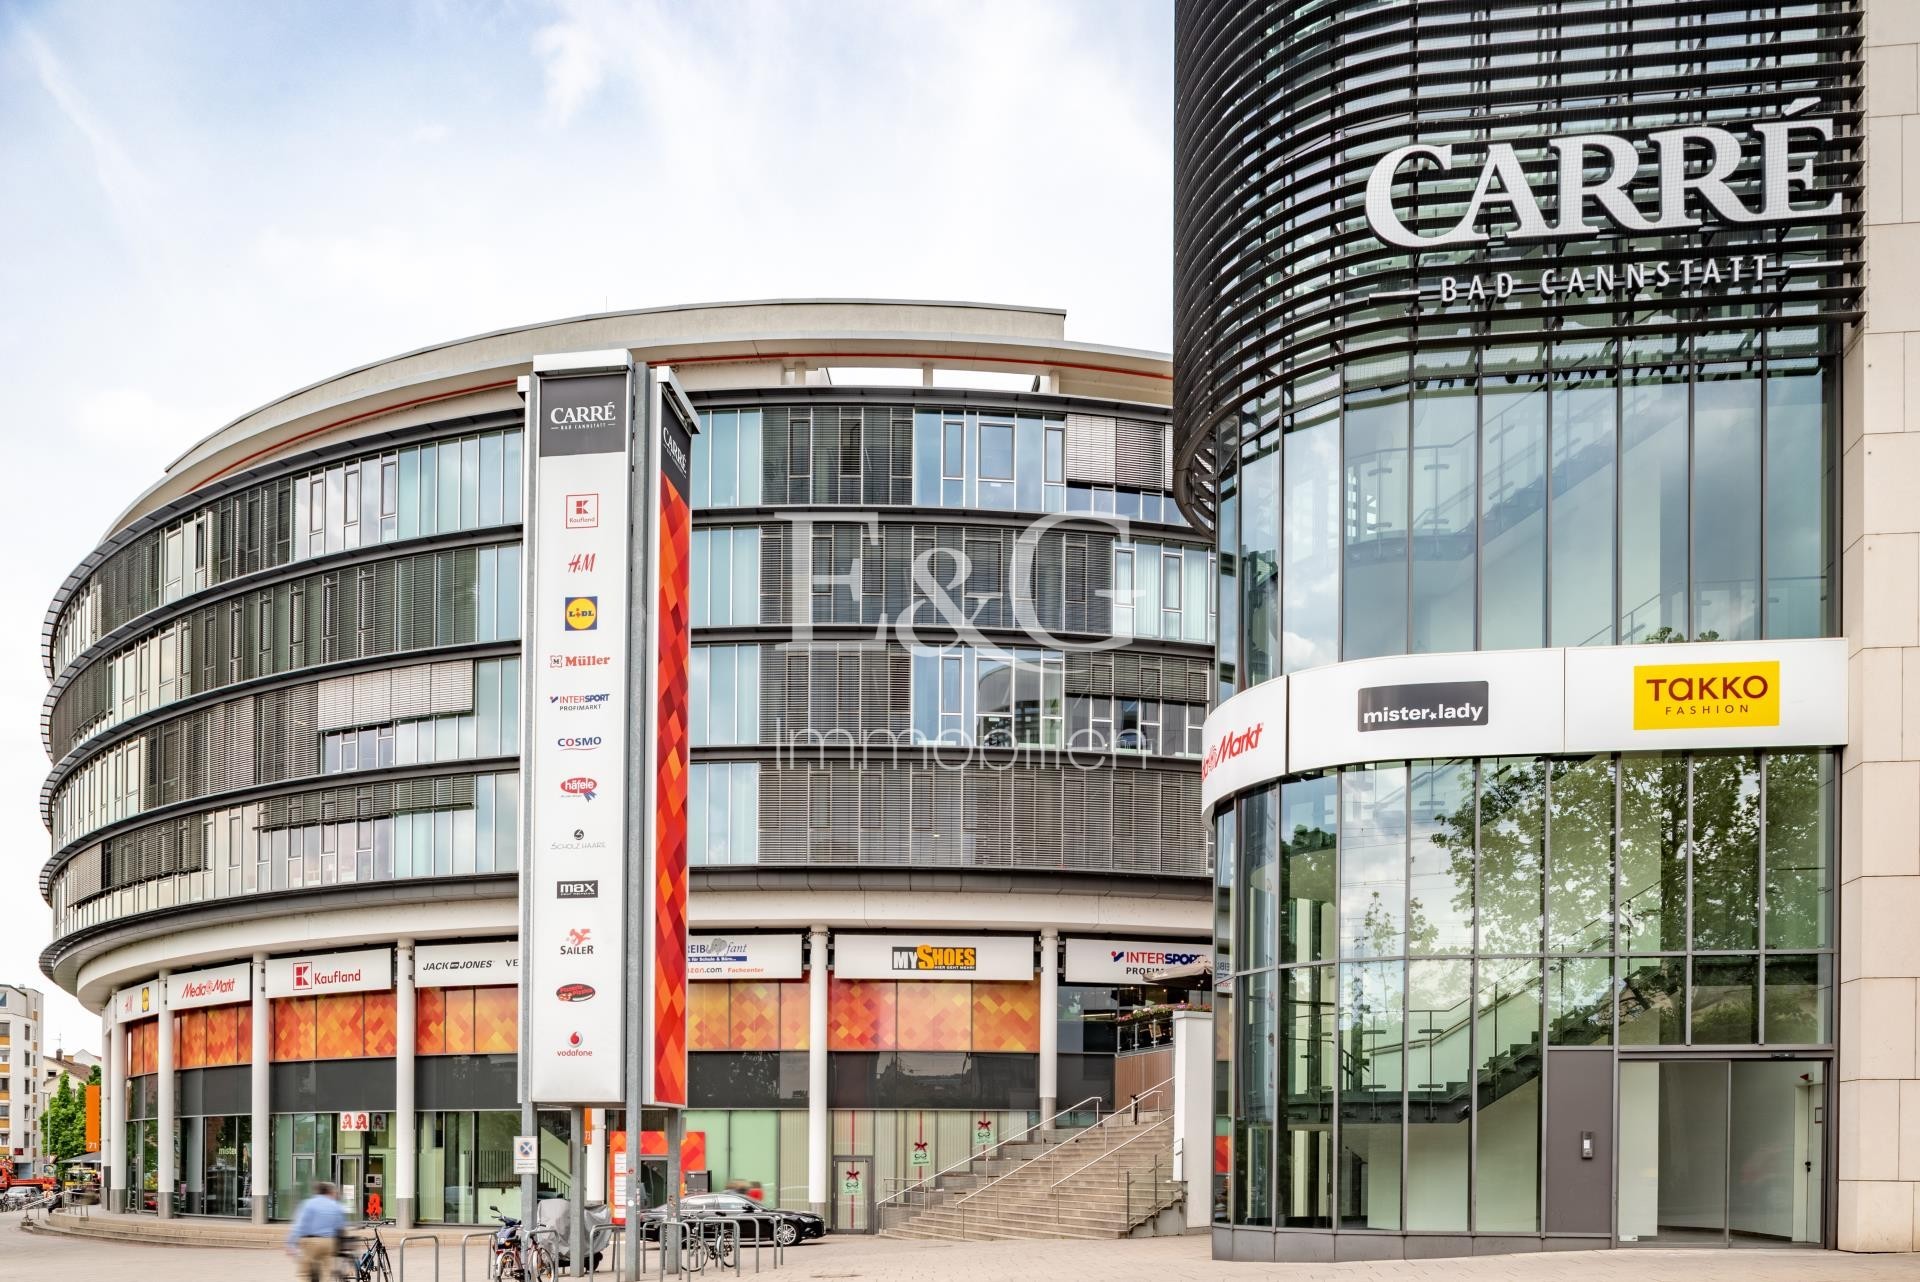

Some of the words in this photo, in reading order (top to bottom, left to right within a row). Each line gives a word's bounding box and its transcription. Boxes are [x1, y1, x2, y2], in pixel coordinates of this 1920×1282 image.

[1364, 96, 1843, 249] CARRÉ
[1440, 272, 1514, 303] BAD
[1541, 254, 1768, 297] CANNSTATT
[550, 401, 616, 424] CARRÉ
[565, 655, 610, 667] Müller
[560, 693, 610, 703] INTERSPORT
[1665, 704, 1749, 716] FASHION
[557, 736, 602, 747] COSMO
[1214, 723, 1263, 768] Markt
[564, 778, 595, 793] häfele
[560, 883, 595, 893] max
[560, 945, 594, 955] SAILER
[423, 961, 450, 971] JACK
[459, 959, 493, 970] JONES
[314, 969, 361, 985] Kaufland
[557, 1049, 593, 1057] vodafone
